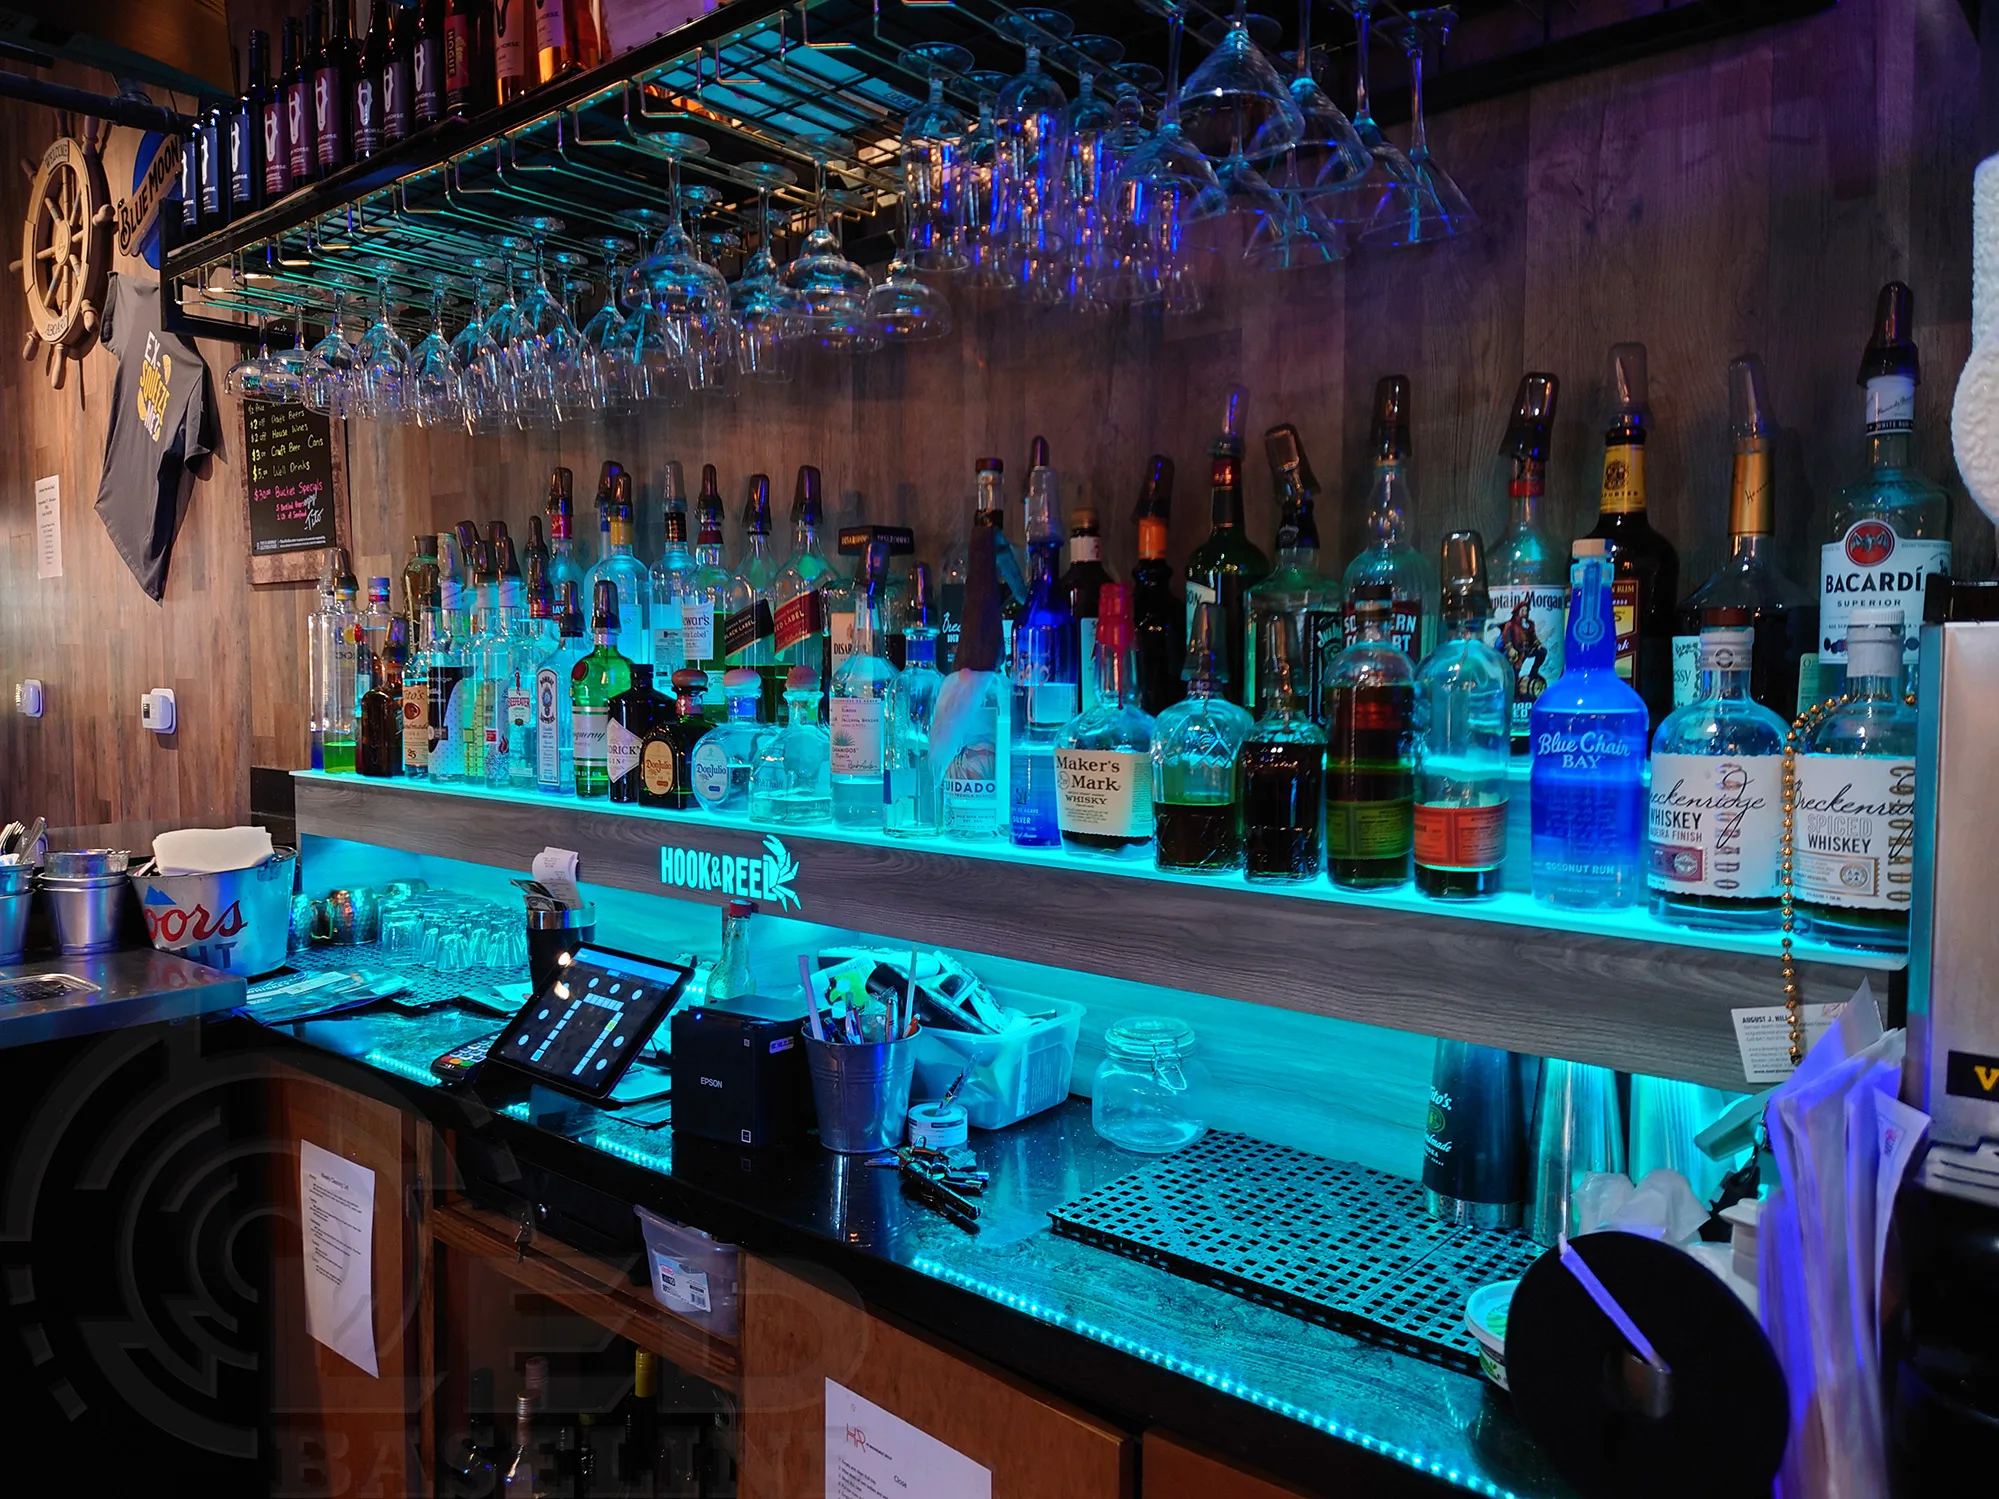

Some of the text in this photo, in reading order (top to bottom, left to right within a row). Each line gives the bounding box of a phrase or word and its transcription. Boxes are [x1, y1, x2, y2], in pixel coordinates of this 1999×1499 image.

[447, 31, 456, 74] HOGUE
[117, 136, 181, 251] BLUE MOON
[288, 441, 301, 453] Beer
[307, 433, 324, 448] Cans
[289, 460, 310, 473] Drinks
[1616, 583, 1635, 594] RUM
[1837, 599, 1903, 608] SUPERIOR
[738, 619, 755, 632] LABEL
[783, 609, 805, 627] LABEL
[1538, 730, 1631, 758] Blue Chair
[1056, 755, 1120, 773] Maker's
[1562, 754, 1599, 769] BAY
[1071, 774, 1120, 792] Mark
[1065, 794, 1108, 805] WHISKY
[1013, 815, 1032, 825] SILVER
[1807, 813, 1853, 838] SPICED
[1671, 830, 1703, 843] FINISH
[1807, 833, 1872, 854] WHISKEY
[1545, 860, 1616, 875] COCONUT RUM
[1742, 1014, 1767, 1024] AUGUST
[700, 1076, 722, 1088] EPSON
[845, 1422, 867, 1453] HR
